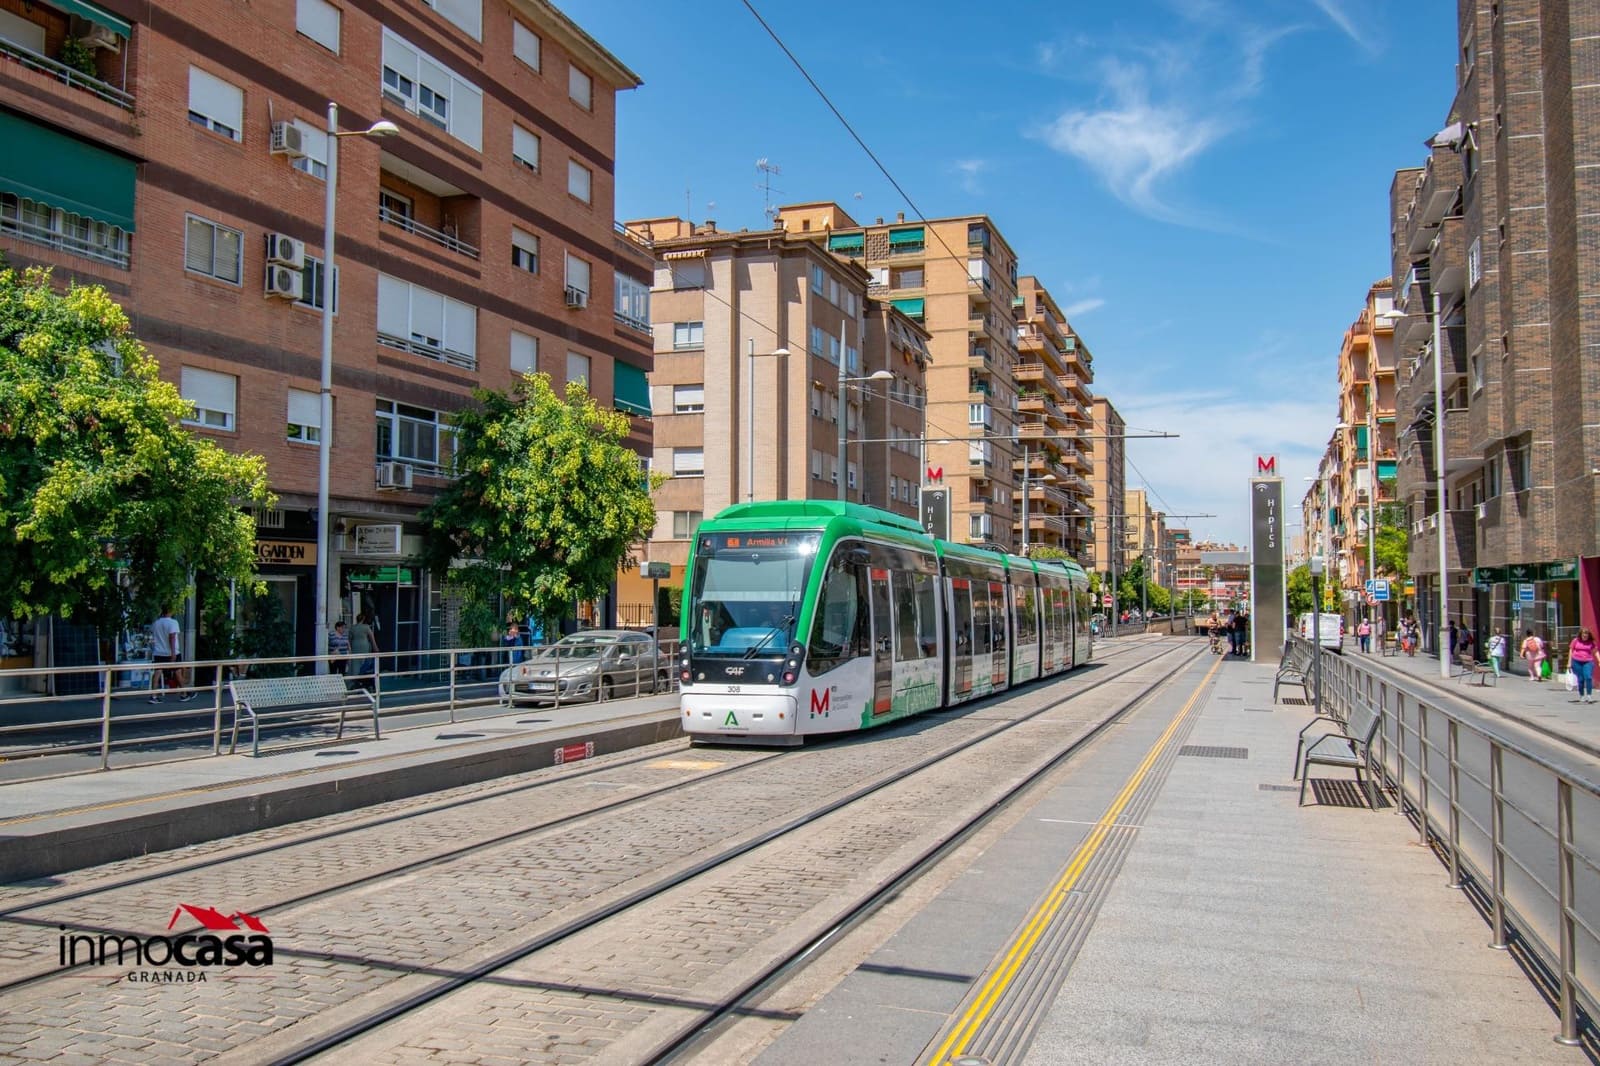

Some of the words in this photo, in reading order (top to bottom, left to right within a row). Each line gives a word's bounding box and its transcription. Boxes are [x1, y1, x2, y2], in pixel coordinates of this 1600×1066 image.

[1257, 456, 1276, 474] M
[927, 467, 943, 483] M
[260, 544, 305, 558] GARDEN
[725, 666, 745, 676] CAF
[810, 687, 830, 719] M
